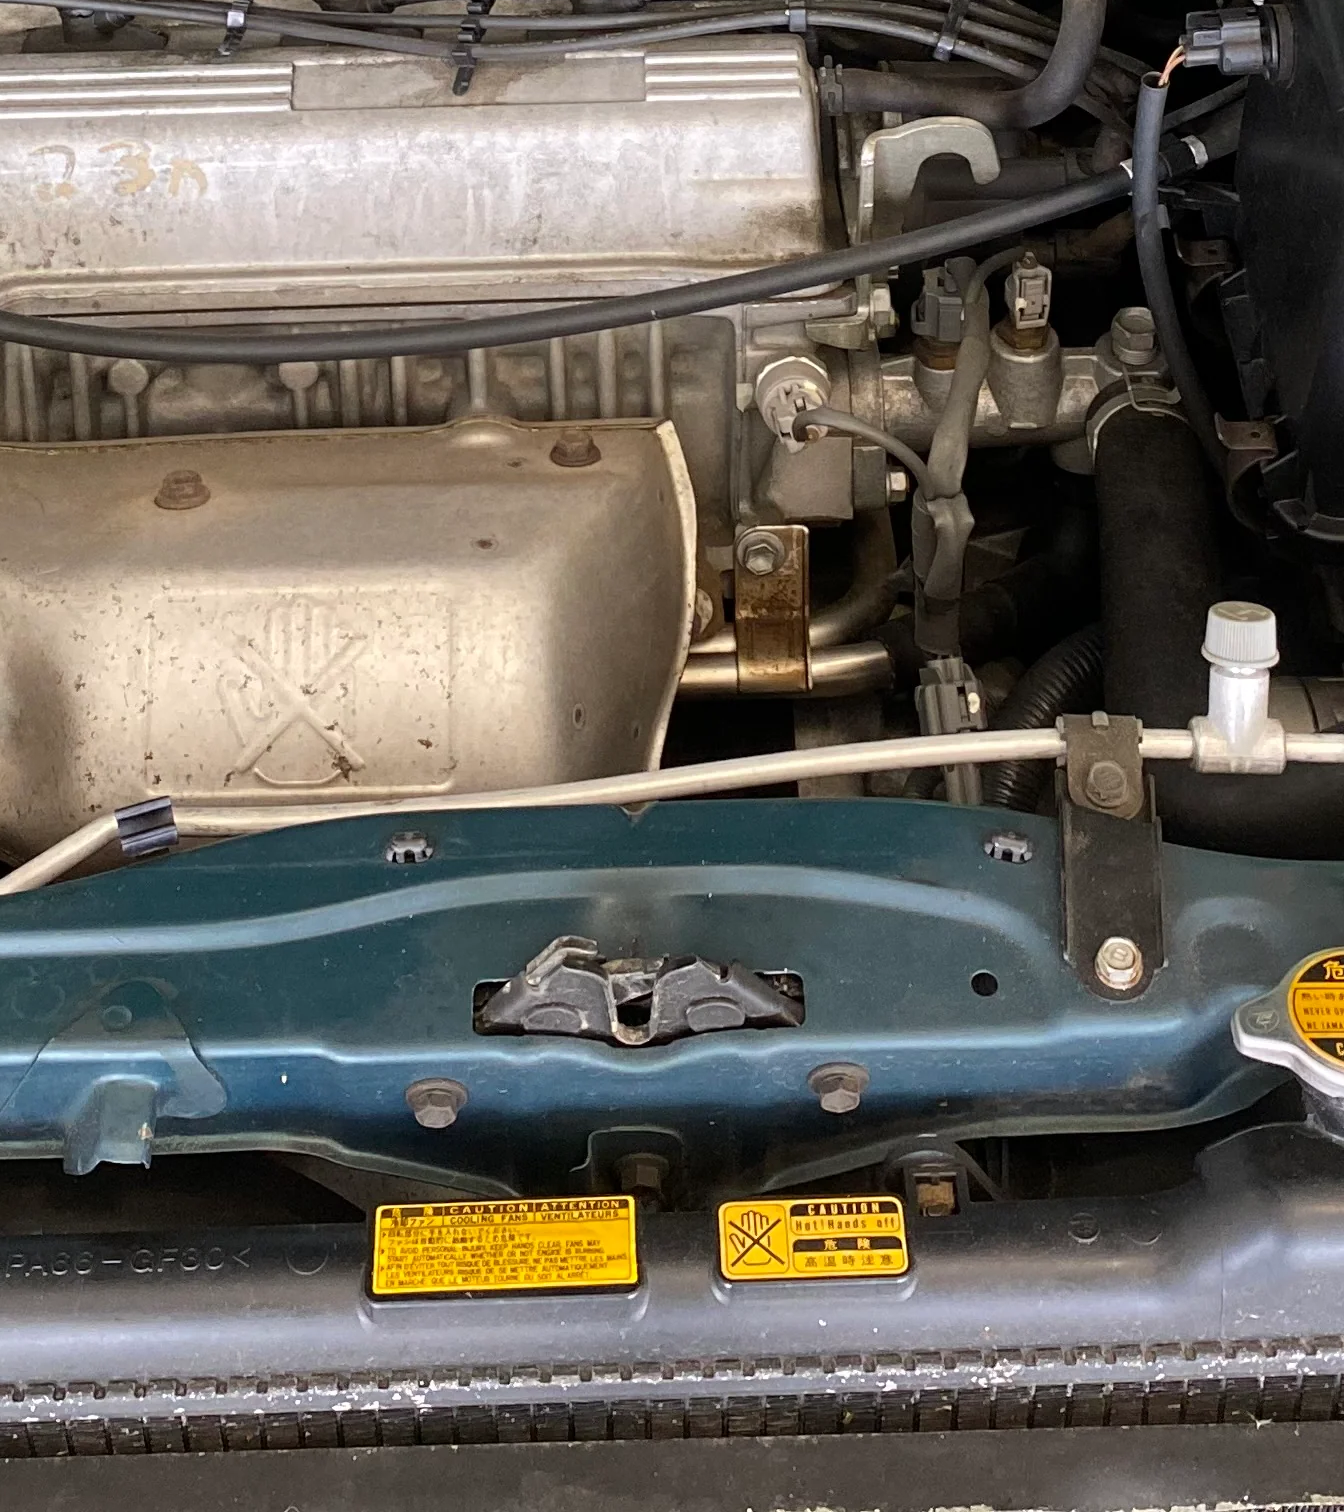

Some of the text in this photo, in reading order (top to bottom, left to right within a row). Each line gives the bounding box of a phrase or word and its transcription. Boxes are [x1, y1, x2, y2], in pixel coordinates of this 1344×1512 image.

[1303, 1007, 1331, 1016] NEVER
[1306, 1021, 1318, 1030] NE
[449, 1203, 528, 1215] CAUTION
[540, 1199, 619, 1211] ATTENTION
[807, 1202, 881, 1216] CAUTION
[449, 1213, 528, 1225] COOLING FANS
[540, 1209, 619, 1221] VENTILATEURS
[876, 1217, 896, 1229] off
[824, 1237, 872, 1251] 危険
[804, 1254, 894, 1269] 高温時注意
